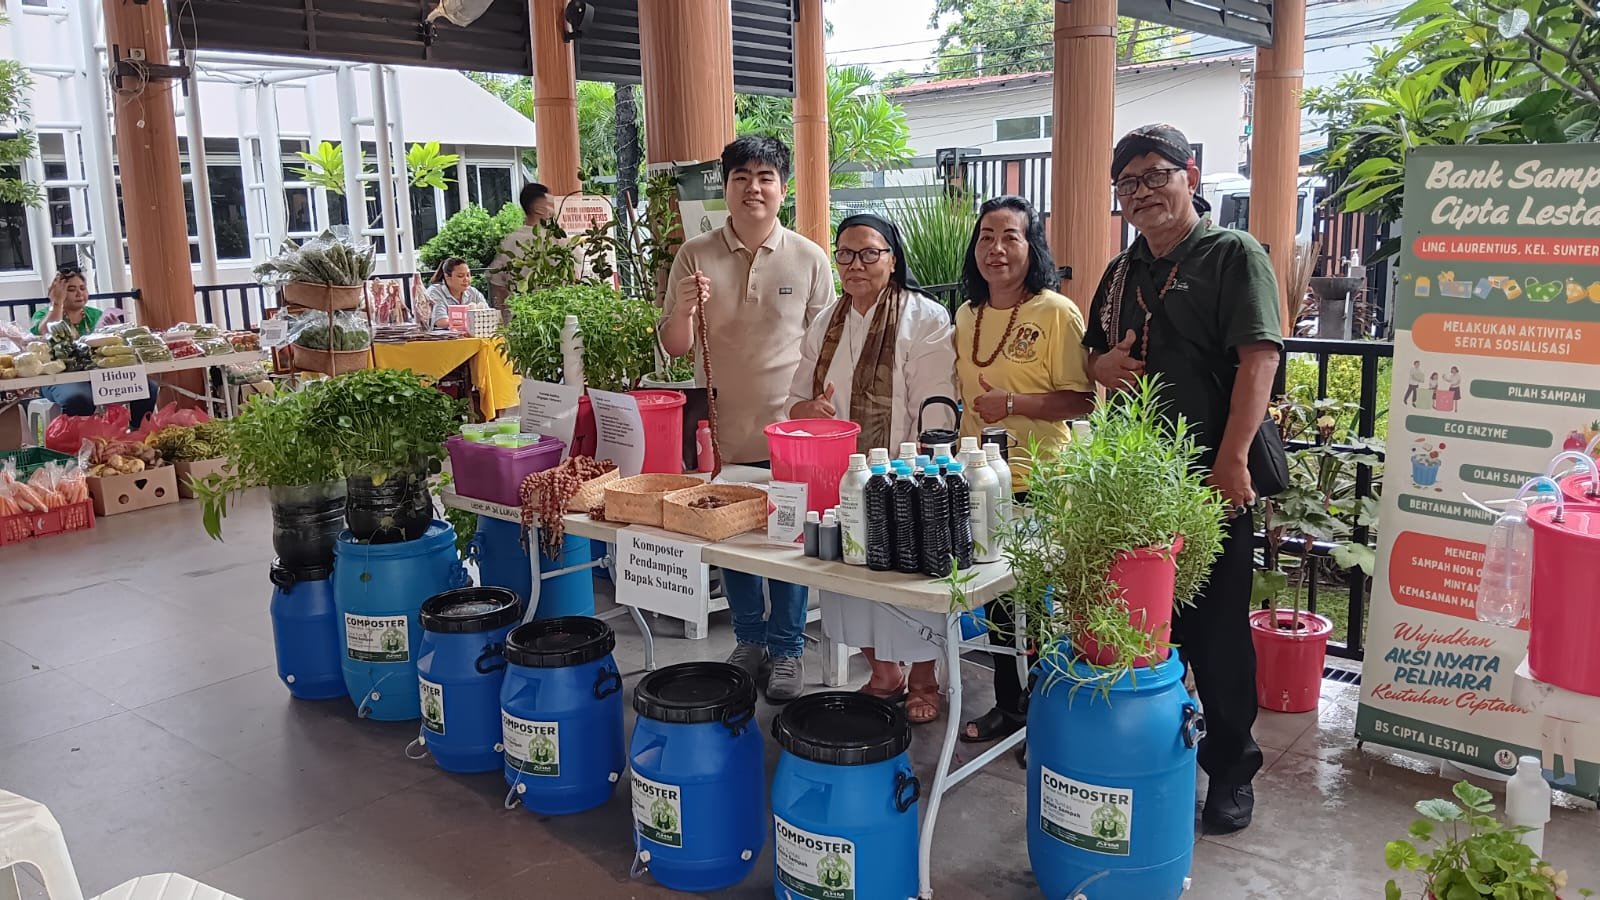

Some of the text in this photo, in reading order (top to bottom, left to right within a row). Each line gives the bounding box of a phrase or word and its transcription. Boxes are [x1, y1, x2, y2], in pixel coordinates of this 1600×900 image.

[1425, 160, 1600, 194] Bank Samp
[1431, 196, 1600, 230] Cipta Lesta
[1451, 242, 1521, 255] LAURENTIUS,
[1524, 243, 1550, 255] KEL.
[1553, 244, 1600, 257] SUNTER
[1443, 320, 1582, 341] MELAKUKAN AKTIVITAS
[1454, 336, 1570, 355] SERTA SOSIALISASI
[102, 371, 136, 381] Hidup
[98, 384, 143, 397] Organis
[1508, 386, 1586, 403] PILAH SAMPAH
[1444, 422, 1509, 439] ECO ENZYME
[1473, 469, 1501, 482] OLAH
[1409, 499, 1461, 515] BERTANAM
[1463, 509, 1493, 521] MINIM
[633, 537, 684, 558] Komposter
[629, 553, 688, 579] Pendamping
[1411, 556, 1451, 572] SAMPAH
[1452, 564, 1474, 576] NON
[624, 569, 694, 596] Bapak Sutarno
[1399, 585, 1458, 606] KEMASANAN
[346, 617, 405, 628] COMPOSTER
[1393, 622, 1496, 650] Wujudkan
[1384, 647, 1500, 673] AKSI NYATA
[1394, 666, 1492, 691] PELIHARA
[1370, 683, 1453, 706] Keutuhan
[1375, 720, 1478, 757] BS CIPTA LESTARI
[1043, 773, 1129, 805] COMPOSTER
[776, 822, 852, 854] COMPOSTER
